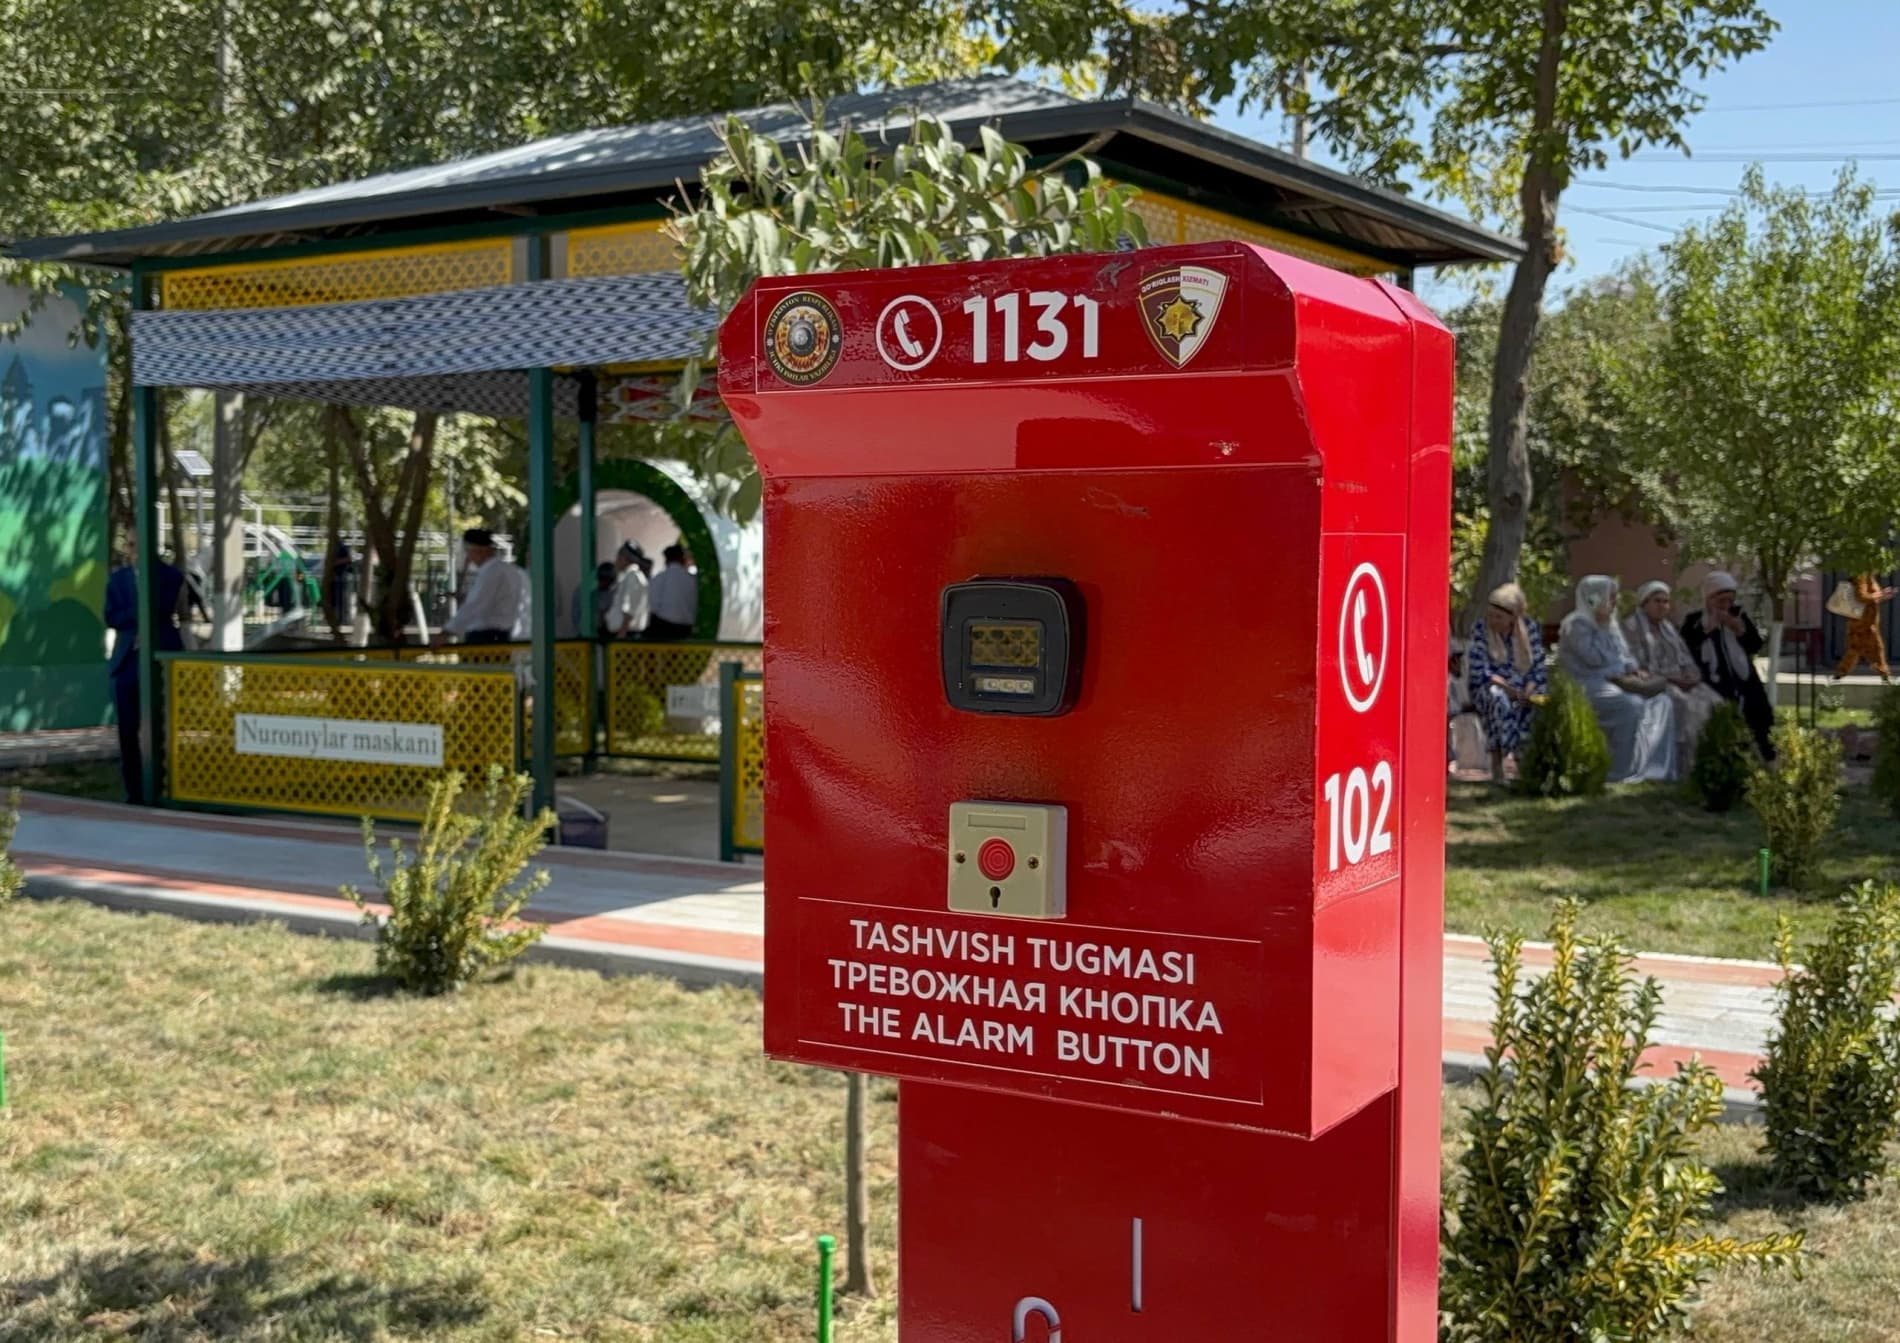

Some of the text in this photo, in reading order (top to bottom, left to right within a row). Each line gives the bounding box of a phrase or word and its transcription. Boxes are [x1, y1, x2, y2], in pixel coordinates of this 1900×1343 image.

[963, 290, 1098, 363] 1131
[353, 727, 438, 756] maskani
[1324, 760, 1392, 872] 102
[850, 919, 1195, 985] TASHVISH TUGMASI
[828, 959, 1223, 1034] ТРЕВОЖНАЯ КНОПКА
[838, 1002, 1210, 1080] THE ALARM BUTTON
